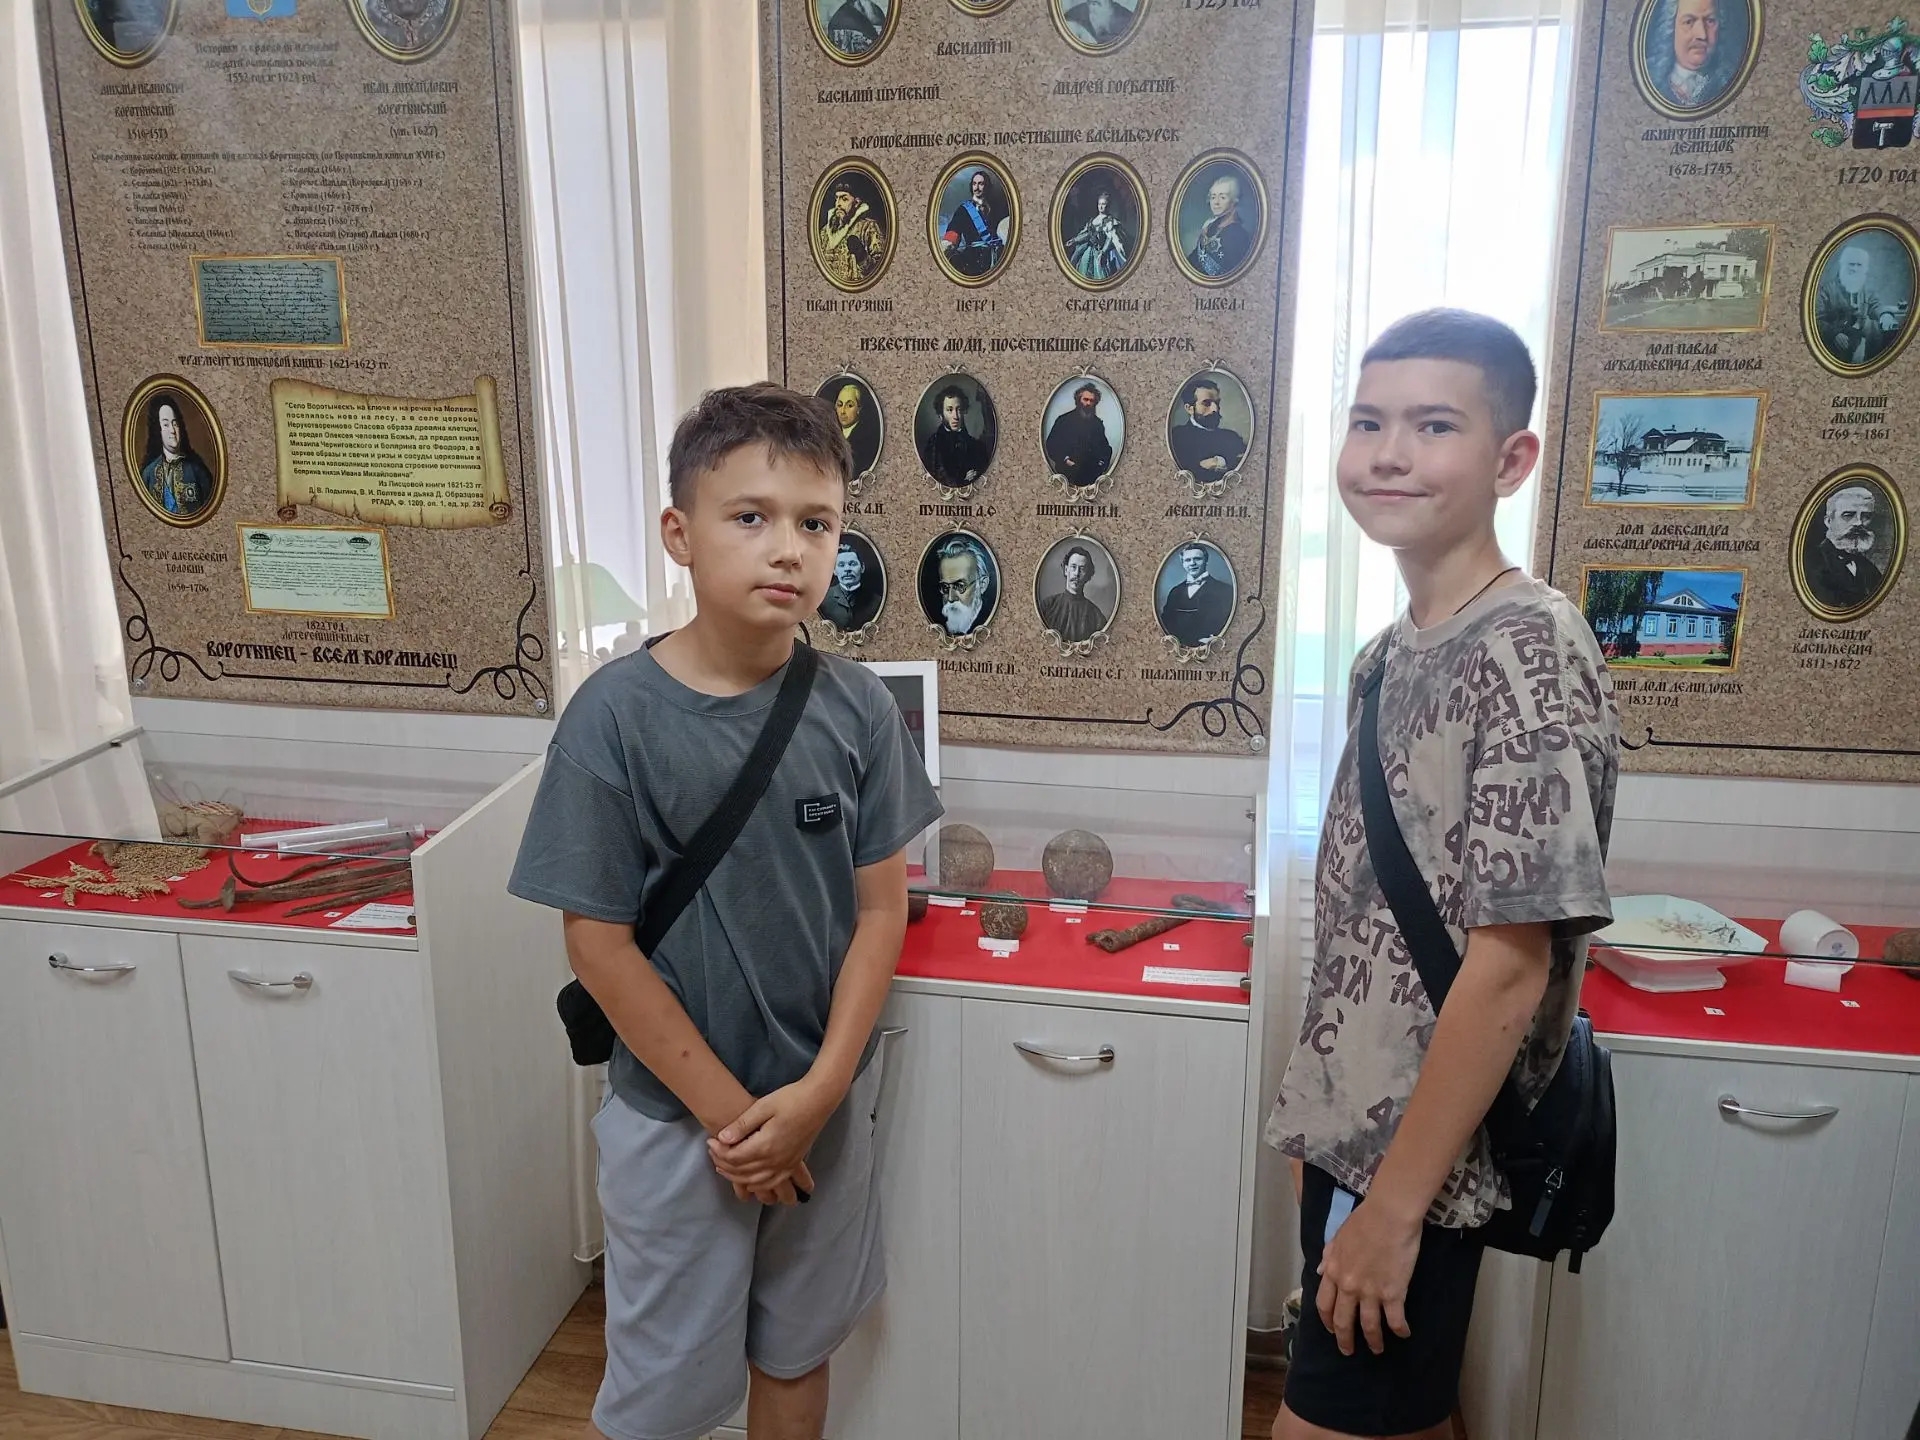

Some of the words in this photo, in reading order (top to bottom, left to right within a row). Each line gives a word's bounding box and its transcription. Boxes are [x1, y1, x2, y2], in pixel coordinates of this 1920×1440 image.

[937, 39, 995, 55] ВАСИЛИЙ
[1000, 41, 1011, 53] III
[1053, 78, 1103, 96] АНДРЕЙ
[1107, 77, 1174, 94] ГОРБАТЫЙ
[818, 87, 872, 103] ВАСИЛИЙ
[875, 84, 940, 101] ШУЙСКИЙ
[850, 133, 943, 149] КОРОНОВАННЫЕ
[947, 132, 989, 147] ОСОБЫ,
[994, 130, 1081, 145] ПОСЕТИВШИЕ
[1086, 128, 1180, 142] ВАСИЛЬСУРСК
[1642, 125, 1705, 140] АКИНФИЙ
[1709, 126, 1769, 138] НИКИТИЧ
[1670, 140, 1734, 155] ДЕМИДОВ
[1669, 163, 1732, 176] 1678-1745
[1839, 167, 1882, 184] 1720
[807, 300, 837, 311] ИВАН
[842, 298, 892, 312] ГРОЗНЫЙ
[956, 299, 987, 312] ПЕТР
[1066, 298, 1138, 312] ЕКАТЕРИНА
[1196, 298, 1236, 310] ПАВЕЛ
[860, 337, 939, 351] ИЗВЕСТНЫЕ
[943, 338, 986, 354] ЛЮДИ,
[991, 338, 1088, 352] ПОСЕТИВШИЕ
[1093, 337, 1195, 352] ВАСИЛЬСУРСК
[1646, 344, 1673, 356] ДОМ
[1678, 343, 1717, 354] ПАВЛА
[330, 358, 376, 369] 1621-1623
[1604, 359, 1689, 373] АРКАДЬЕВИЧА
[1692, 358, 1762, 372] ДЕМИДОВА
[1832, 395, 1888, 407] ВАСИЛИЙ
[1831, 412, 1884, 424] ЛЬВОВИЧ
[1822, 429, 1849, 440] 1769
[1865, 429, 1890, 440] 1861
[321, 441, 372, 449] Черниговского
[920, 504, 972, 516] ПУШКИН
[1036, 504, 1093, 517] ШИШКИН
[1165, 505, 1222, 517] ЛЕВИТАН
[1616, 524, 1644, 535] ДОМ
[1651, 524, 1729, 536] АЛЕКСАНДРА
[1583, 539, 1689, 551] АЛЕКСАНДРОВИЧА
[1693, 540, 1760, 552] ДЕМИДОВА
[172, 552, 228, 562] АЛЕКСЕЕВИЧ
[166, 563, 204, 574] ГОЛОВИН
[1799, 629, 1871, 641] АЛЕКСАНДР
[1792, 643, 1872, 655] ВАСИЛЬЕВИЧ
[206, 641, 297, 664] ВОРОТЫНЕЦ
[313, 646, 359, 664] ВСЕМ
[363, 650, 458, 671] КОРМИЛЕЦ!
[1800, 658, 1860, 669] 1811-1872
[1040, 666, 1101, 679] СКИТАЛЕЦ
[1142, 669, 1201, 680] ШАЛЯПИН
[1640, 680, 1666, 692] ДОМ
[1670, 681, 1743, 694] ДЕМИДОВЫХ
[1628, 696, 1653, 706] 1832
